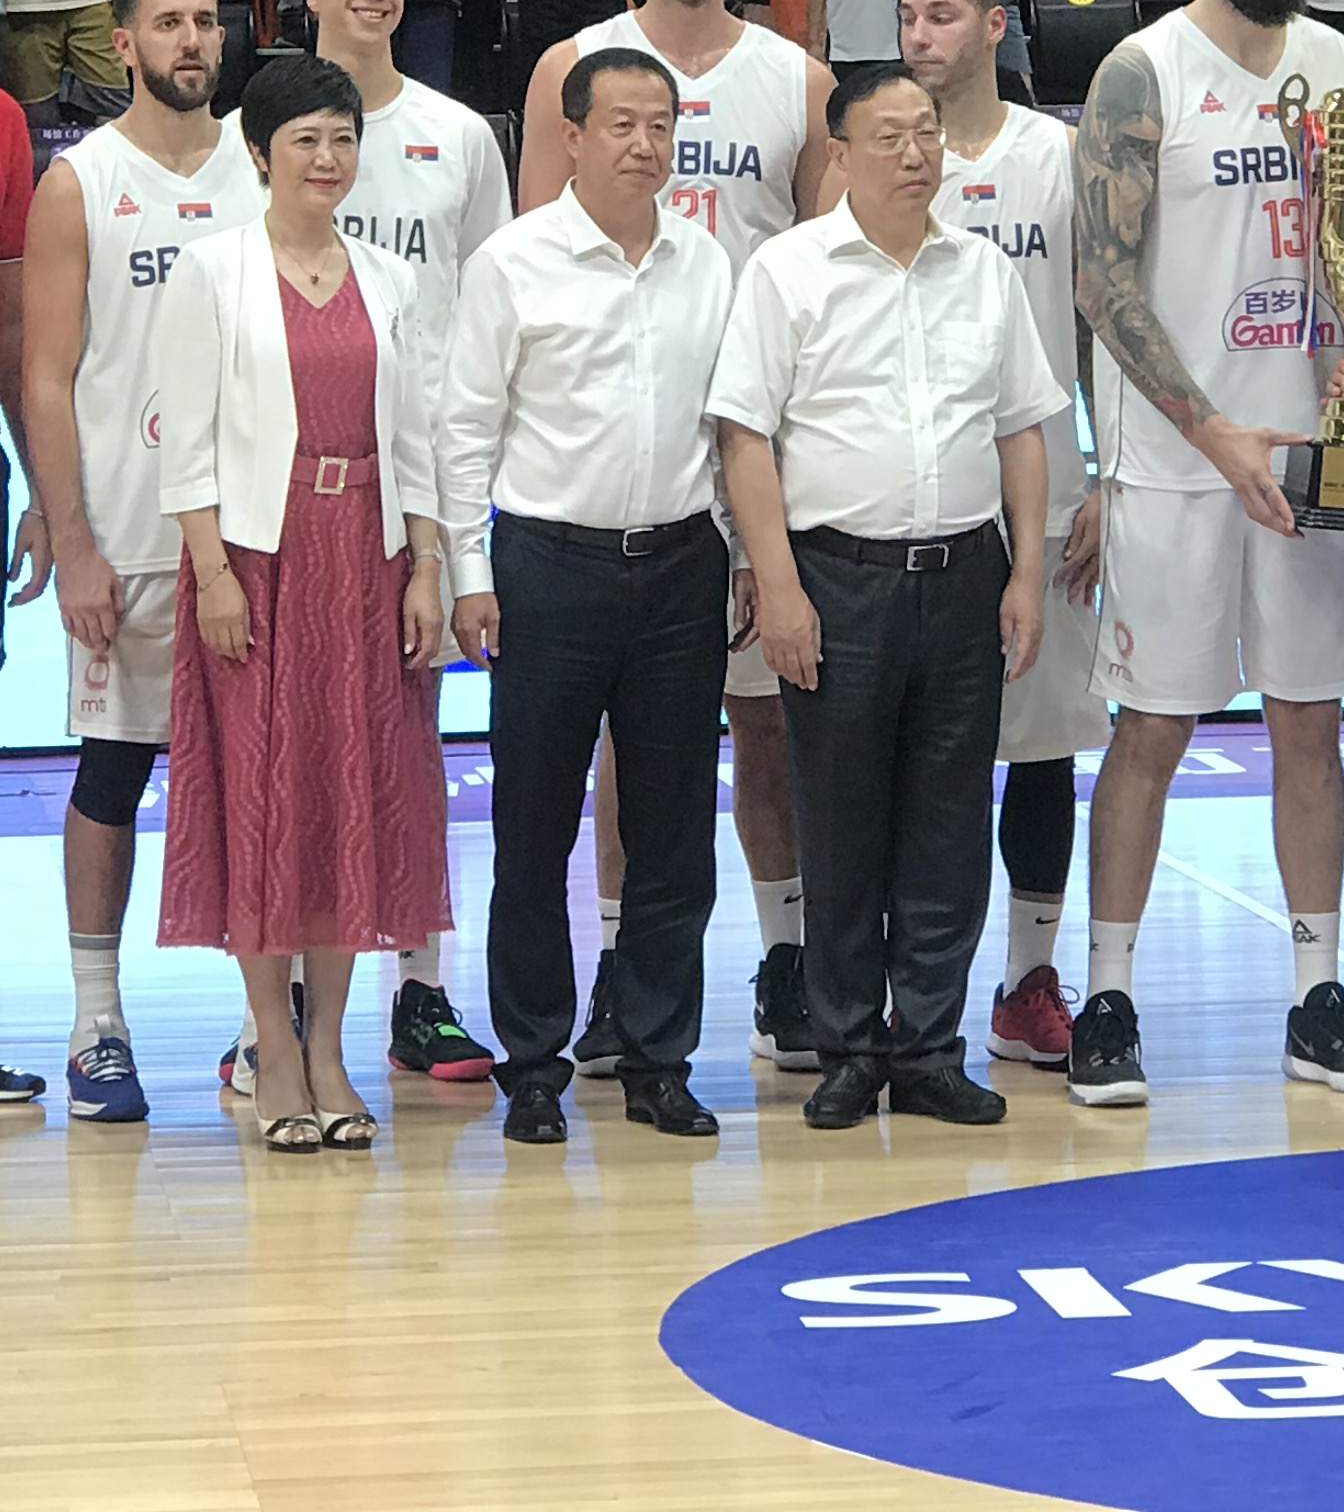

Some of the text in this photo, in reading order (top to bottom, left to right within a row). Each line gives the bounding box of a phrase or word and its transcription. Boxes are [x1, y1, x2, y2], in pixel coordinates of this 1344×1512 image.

[672, 139, 762, 183] BIJA
[1214, 145, 1302, 187] SRBI
[671, 189, 718, 235] 21
[1262, 199, 1305, 259] 13
[333, 215, 427, 264] BIJA
[967, 223, 1048, 259] IJA
